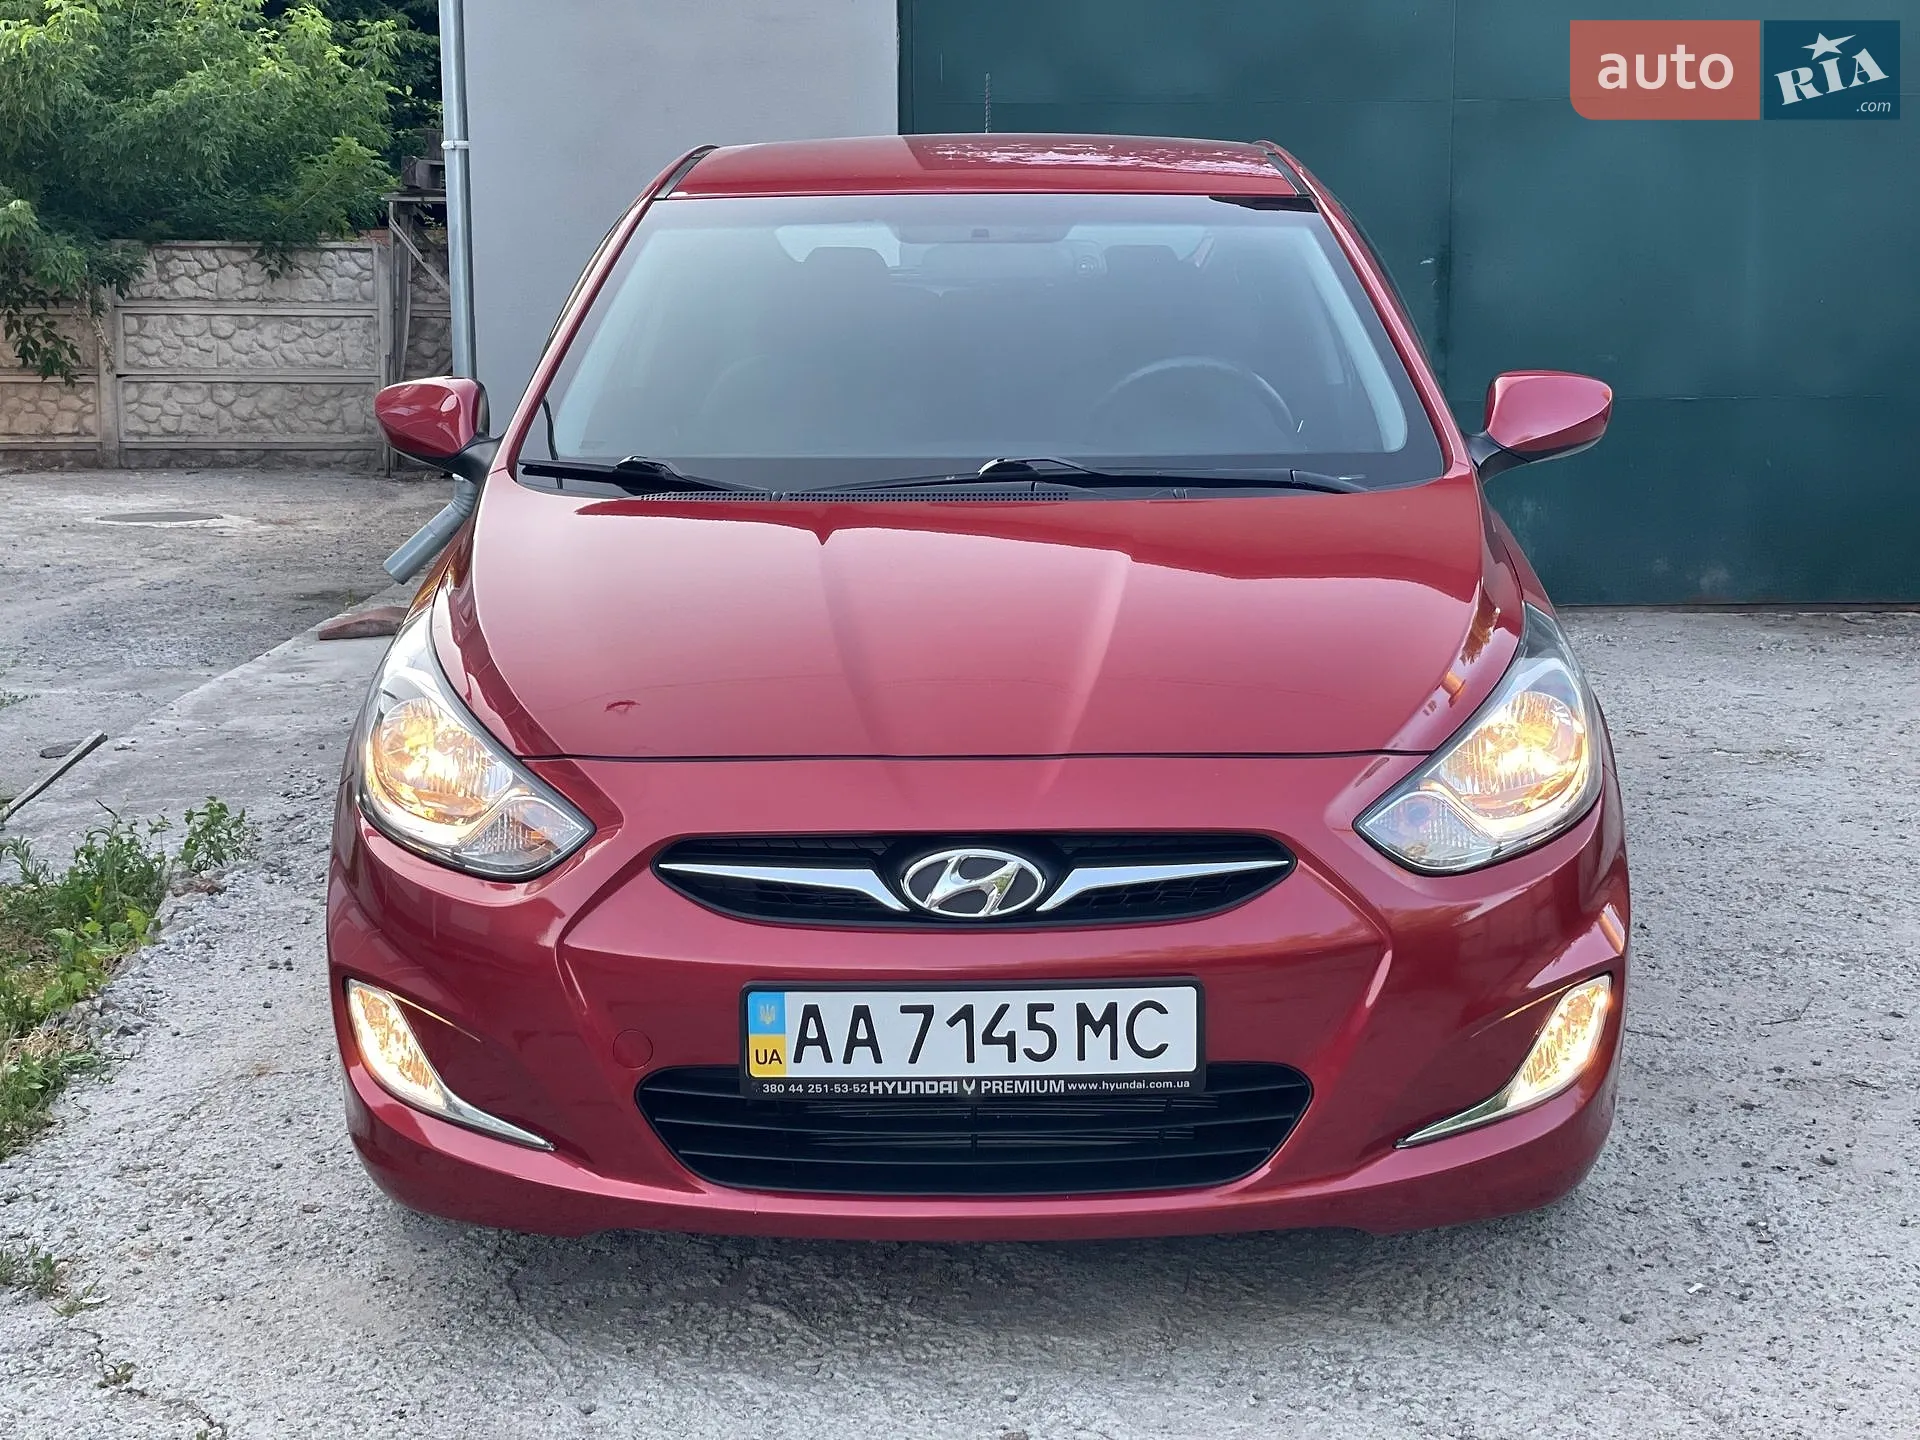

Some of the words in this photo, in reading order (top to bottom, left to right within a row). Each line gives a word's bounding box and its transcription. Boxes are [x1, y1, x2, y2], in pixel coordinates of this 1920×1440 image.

[793, 1004, 883, 1064] AA
[899, 1003, 1057, 1064] 7145
[1076, 1000, 1169, 1061] MC
[755, 1049, 782, 1065] UA
[762, 1083, 785, 1094] 380
[788, 1083, 804, 1094] 44
[807, 1083, 868, 1094] 251-53-52
[869, 1080, 958, 1095] HYUNDAI
[980, 1079, 1065, 1094] PREMIUM
[1067, 1079, 1191, 1092] www.hyundai.com.ua
